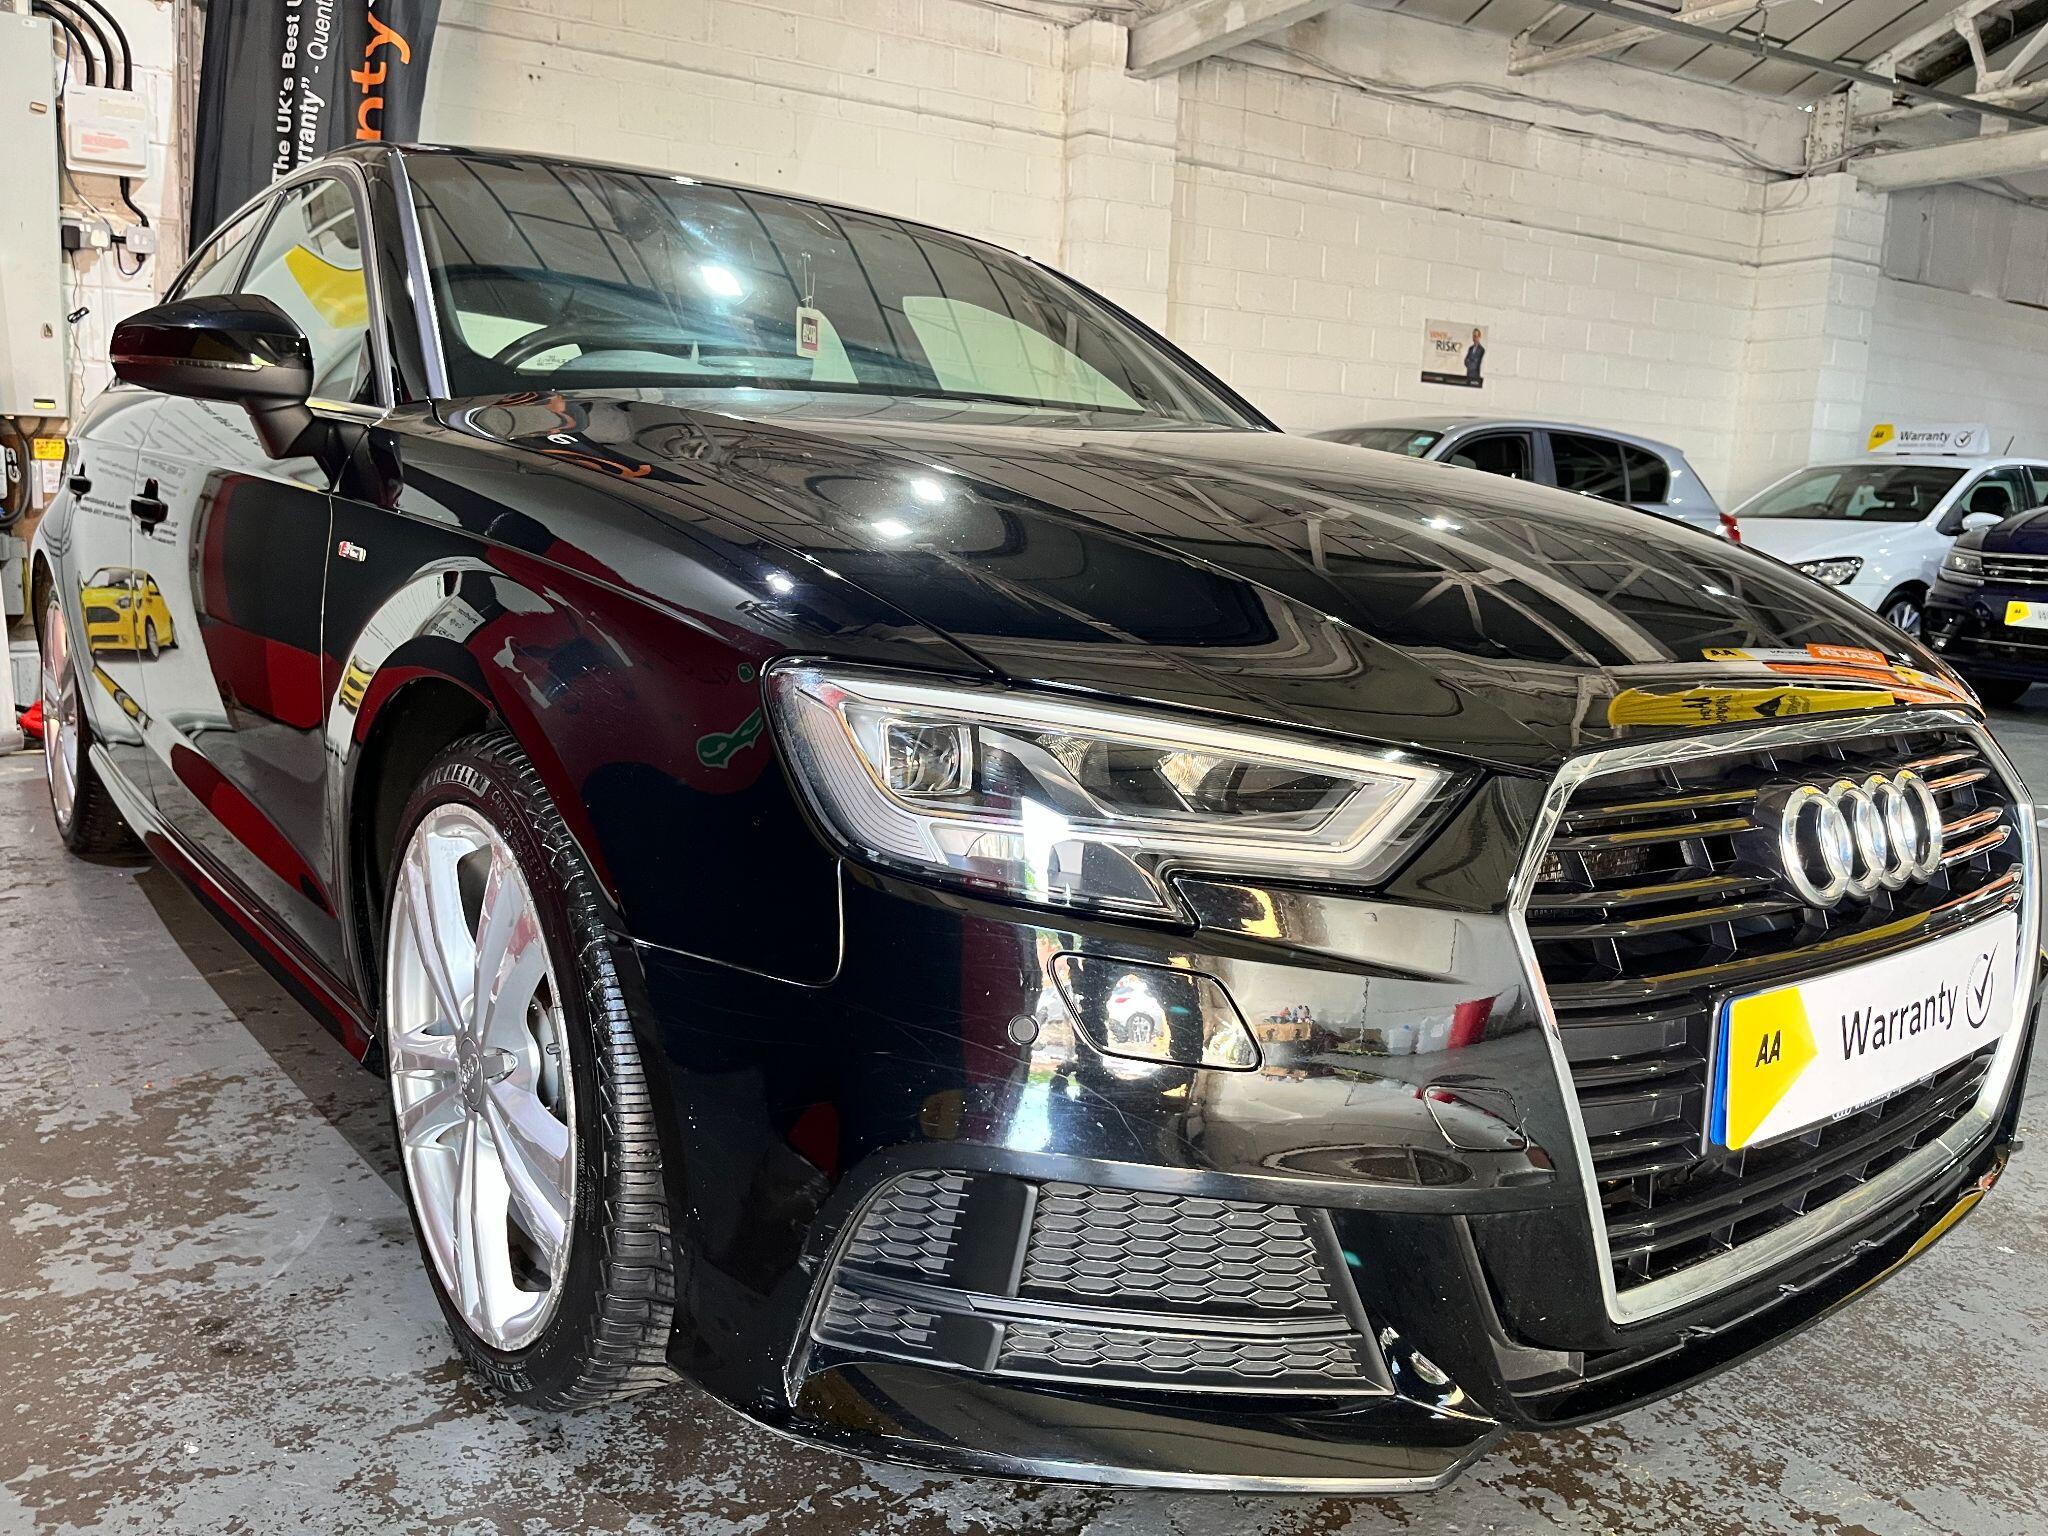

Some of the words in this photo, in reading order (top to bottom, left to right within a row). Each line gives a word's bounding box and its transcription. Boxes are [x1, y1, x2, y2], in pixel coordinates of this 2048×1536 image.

[281, 14, 301, 70] Best
[276, 77, 294, 133] UK's
[272, 139, 291, 182] The
[1900, 431, 1952, 443] Warranty
[1755, 1029, 1781, 1068] AA
[1842, 980, 1958, 1060] Warranty
